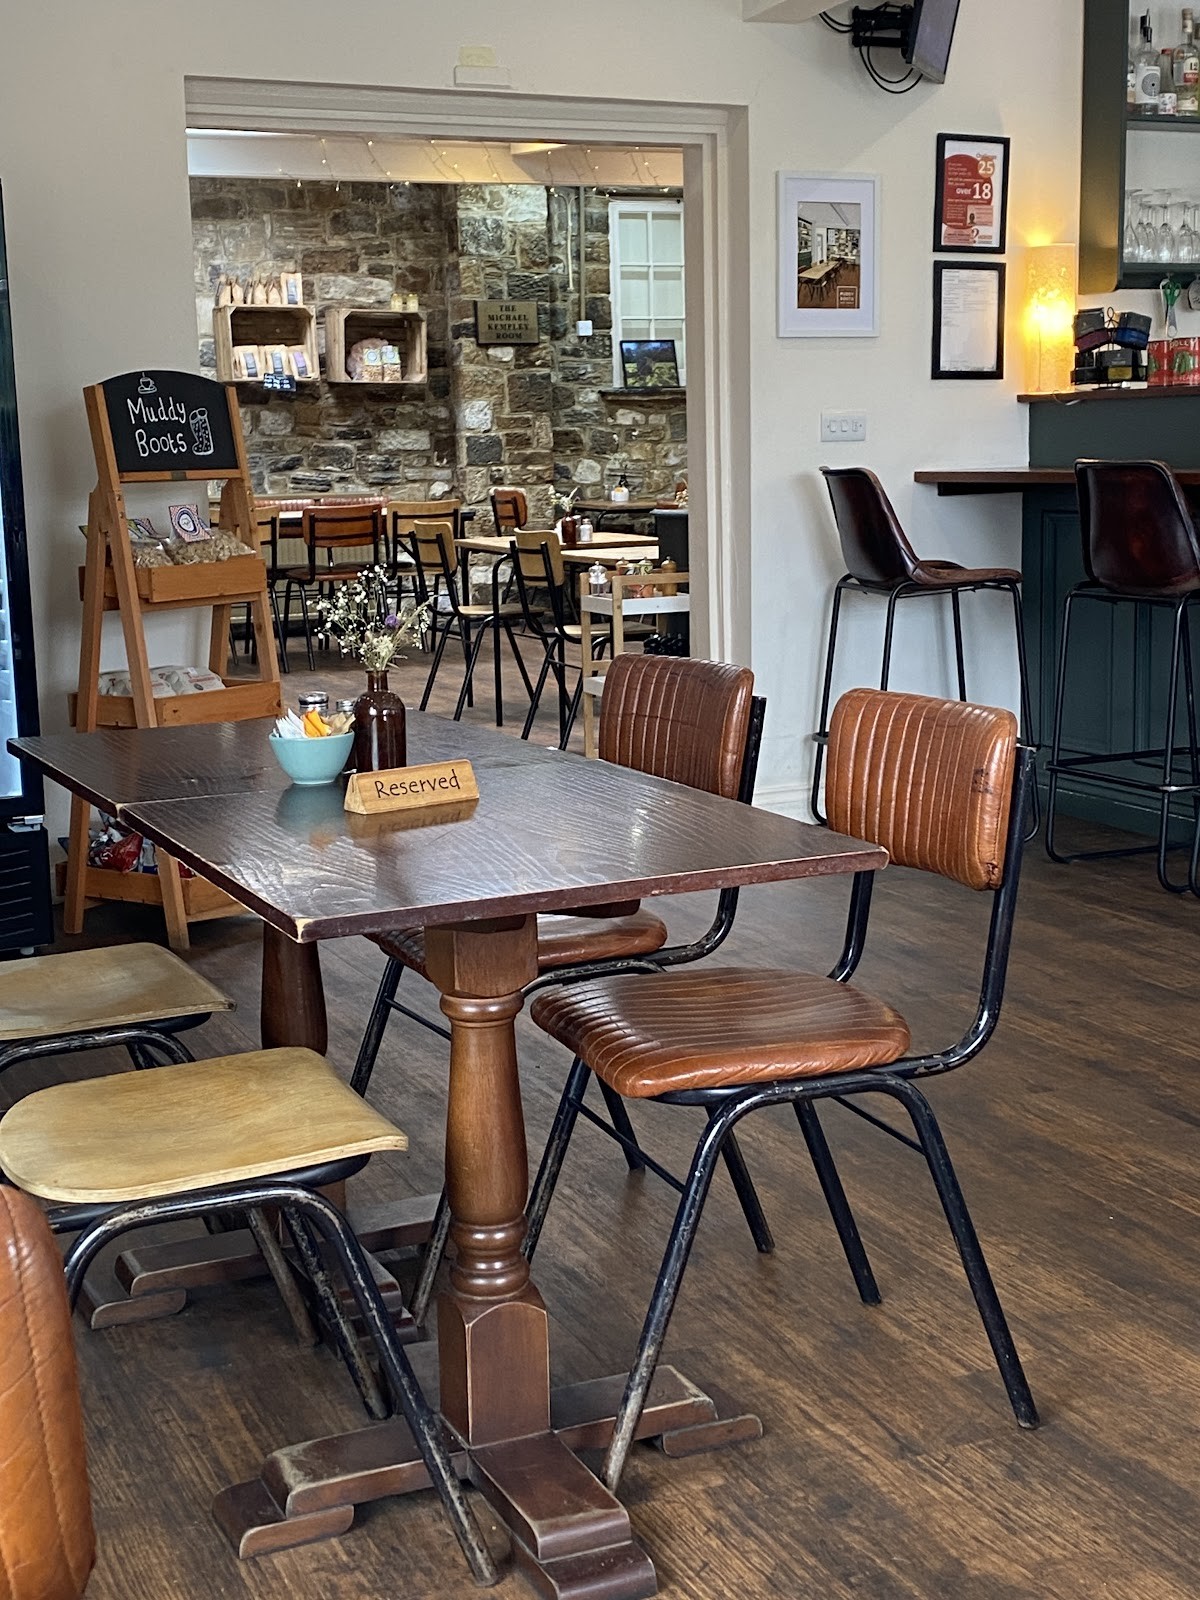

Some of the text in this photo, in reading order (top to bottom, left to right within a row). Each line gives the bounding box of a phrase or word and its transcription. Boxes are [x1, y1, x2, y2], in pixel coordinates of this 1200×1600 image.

[978, 160, 994, 174] 25
[956, 182, 992, 199] over 18
[499, 304, 516, 312] THE
[487, 323, 529, 331] KEMPLEY
[496, 332, 522, 340] ROOM
[126, 396, 187, 425] Muddy
[135, 428, 188, 458] Boots
[374, 768, 461, 799] Reserved
